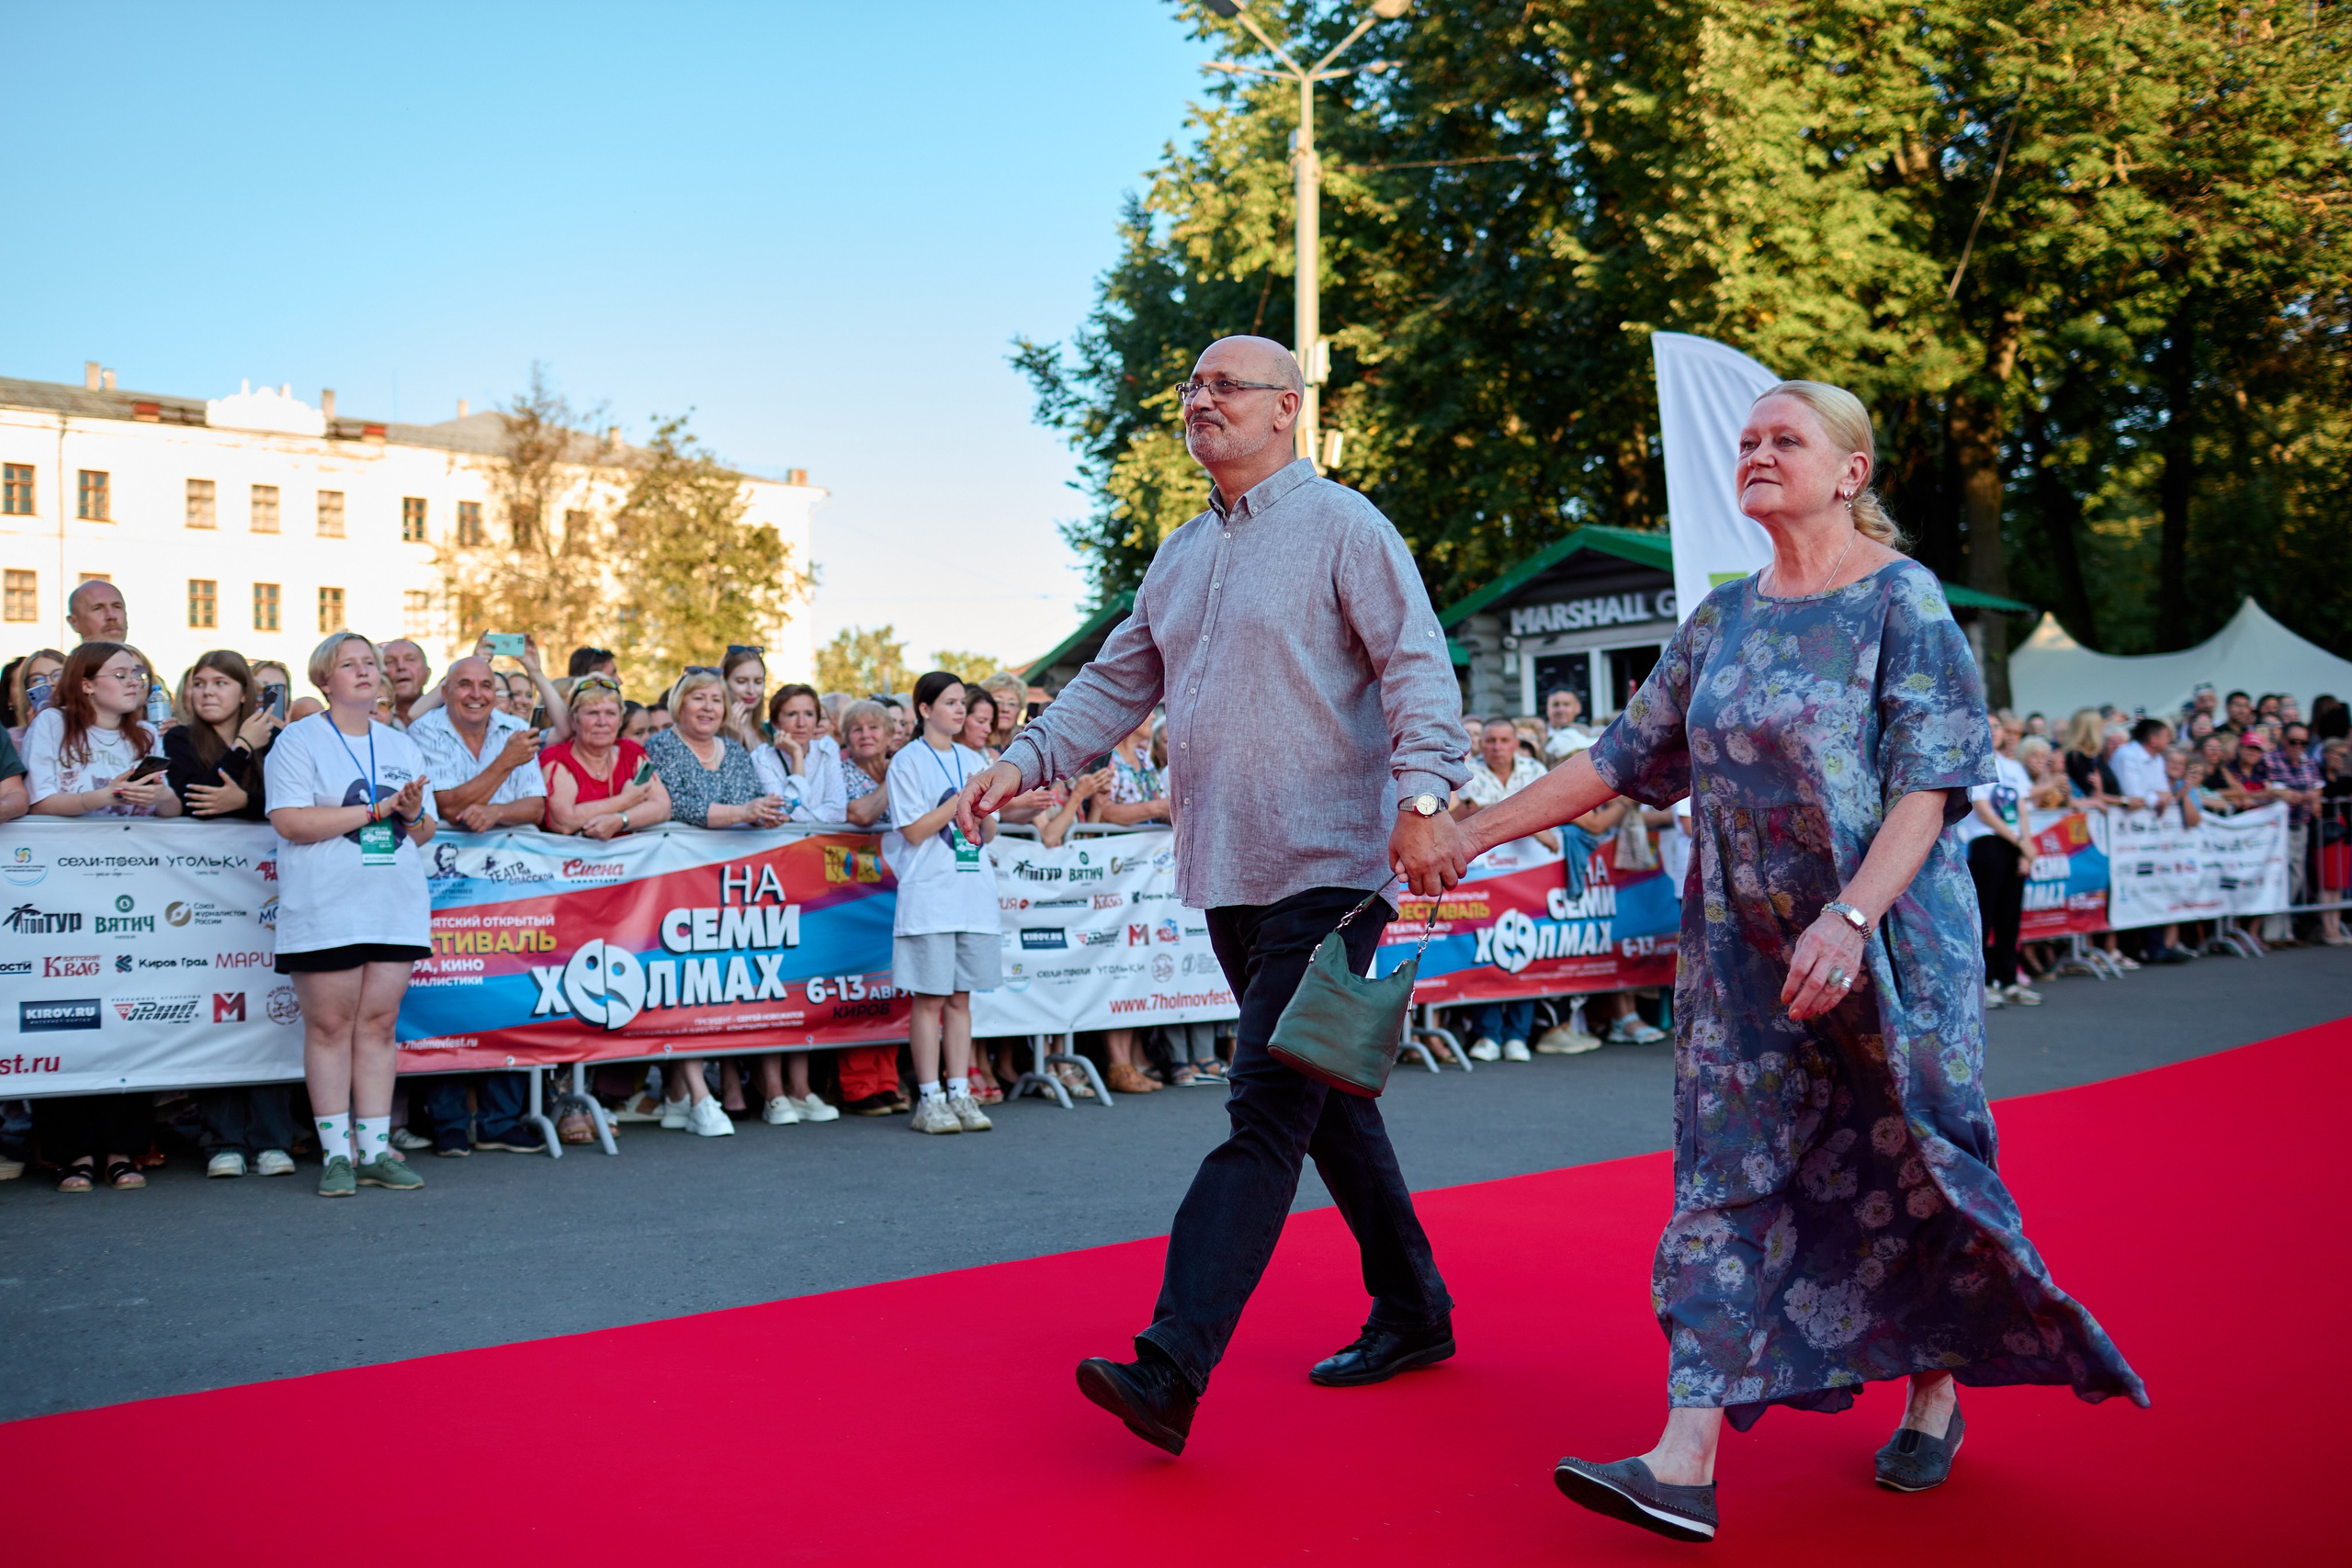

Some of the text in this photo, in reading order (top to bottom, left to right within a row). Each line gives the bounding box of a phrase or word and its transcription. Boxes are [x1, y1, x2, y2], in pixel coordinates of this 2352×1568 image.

[1510, 593, 1652, 635] MARSHALL
[488, 862, 525, 885] ТЕАТР
[724, 863, 786, 905] НА
[95, 915, 155, 935] ВЯТИЧ
[432, 916, 481, 929] ЯТСКИЙ
[482, 914, 555, 927] ОТКРЫТЫЙ
[662, 905, 801, 953] СЕМИ
[139, 957, 209, 969] Киров Град
[215, 952, 276, 969] МАРИ
[441, 958, 485, 972] КИНО
[408, 976, 483, 987] НАЛИСТИКИ
[806, 975, 866, 1004] 6-13
[26, 1006, 96, 1020] KIROV.RU
[832, 1002, 890, 1020] КИРОВ
[0, 1054, 61, 1075] st.ru
